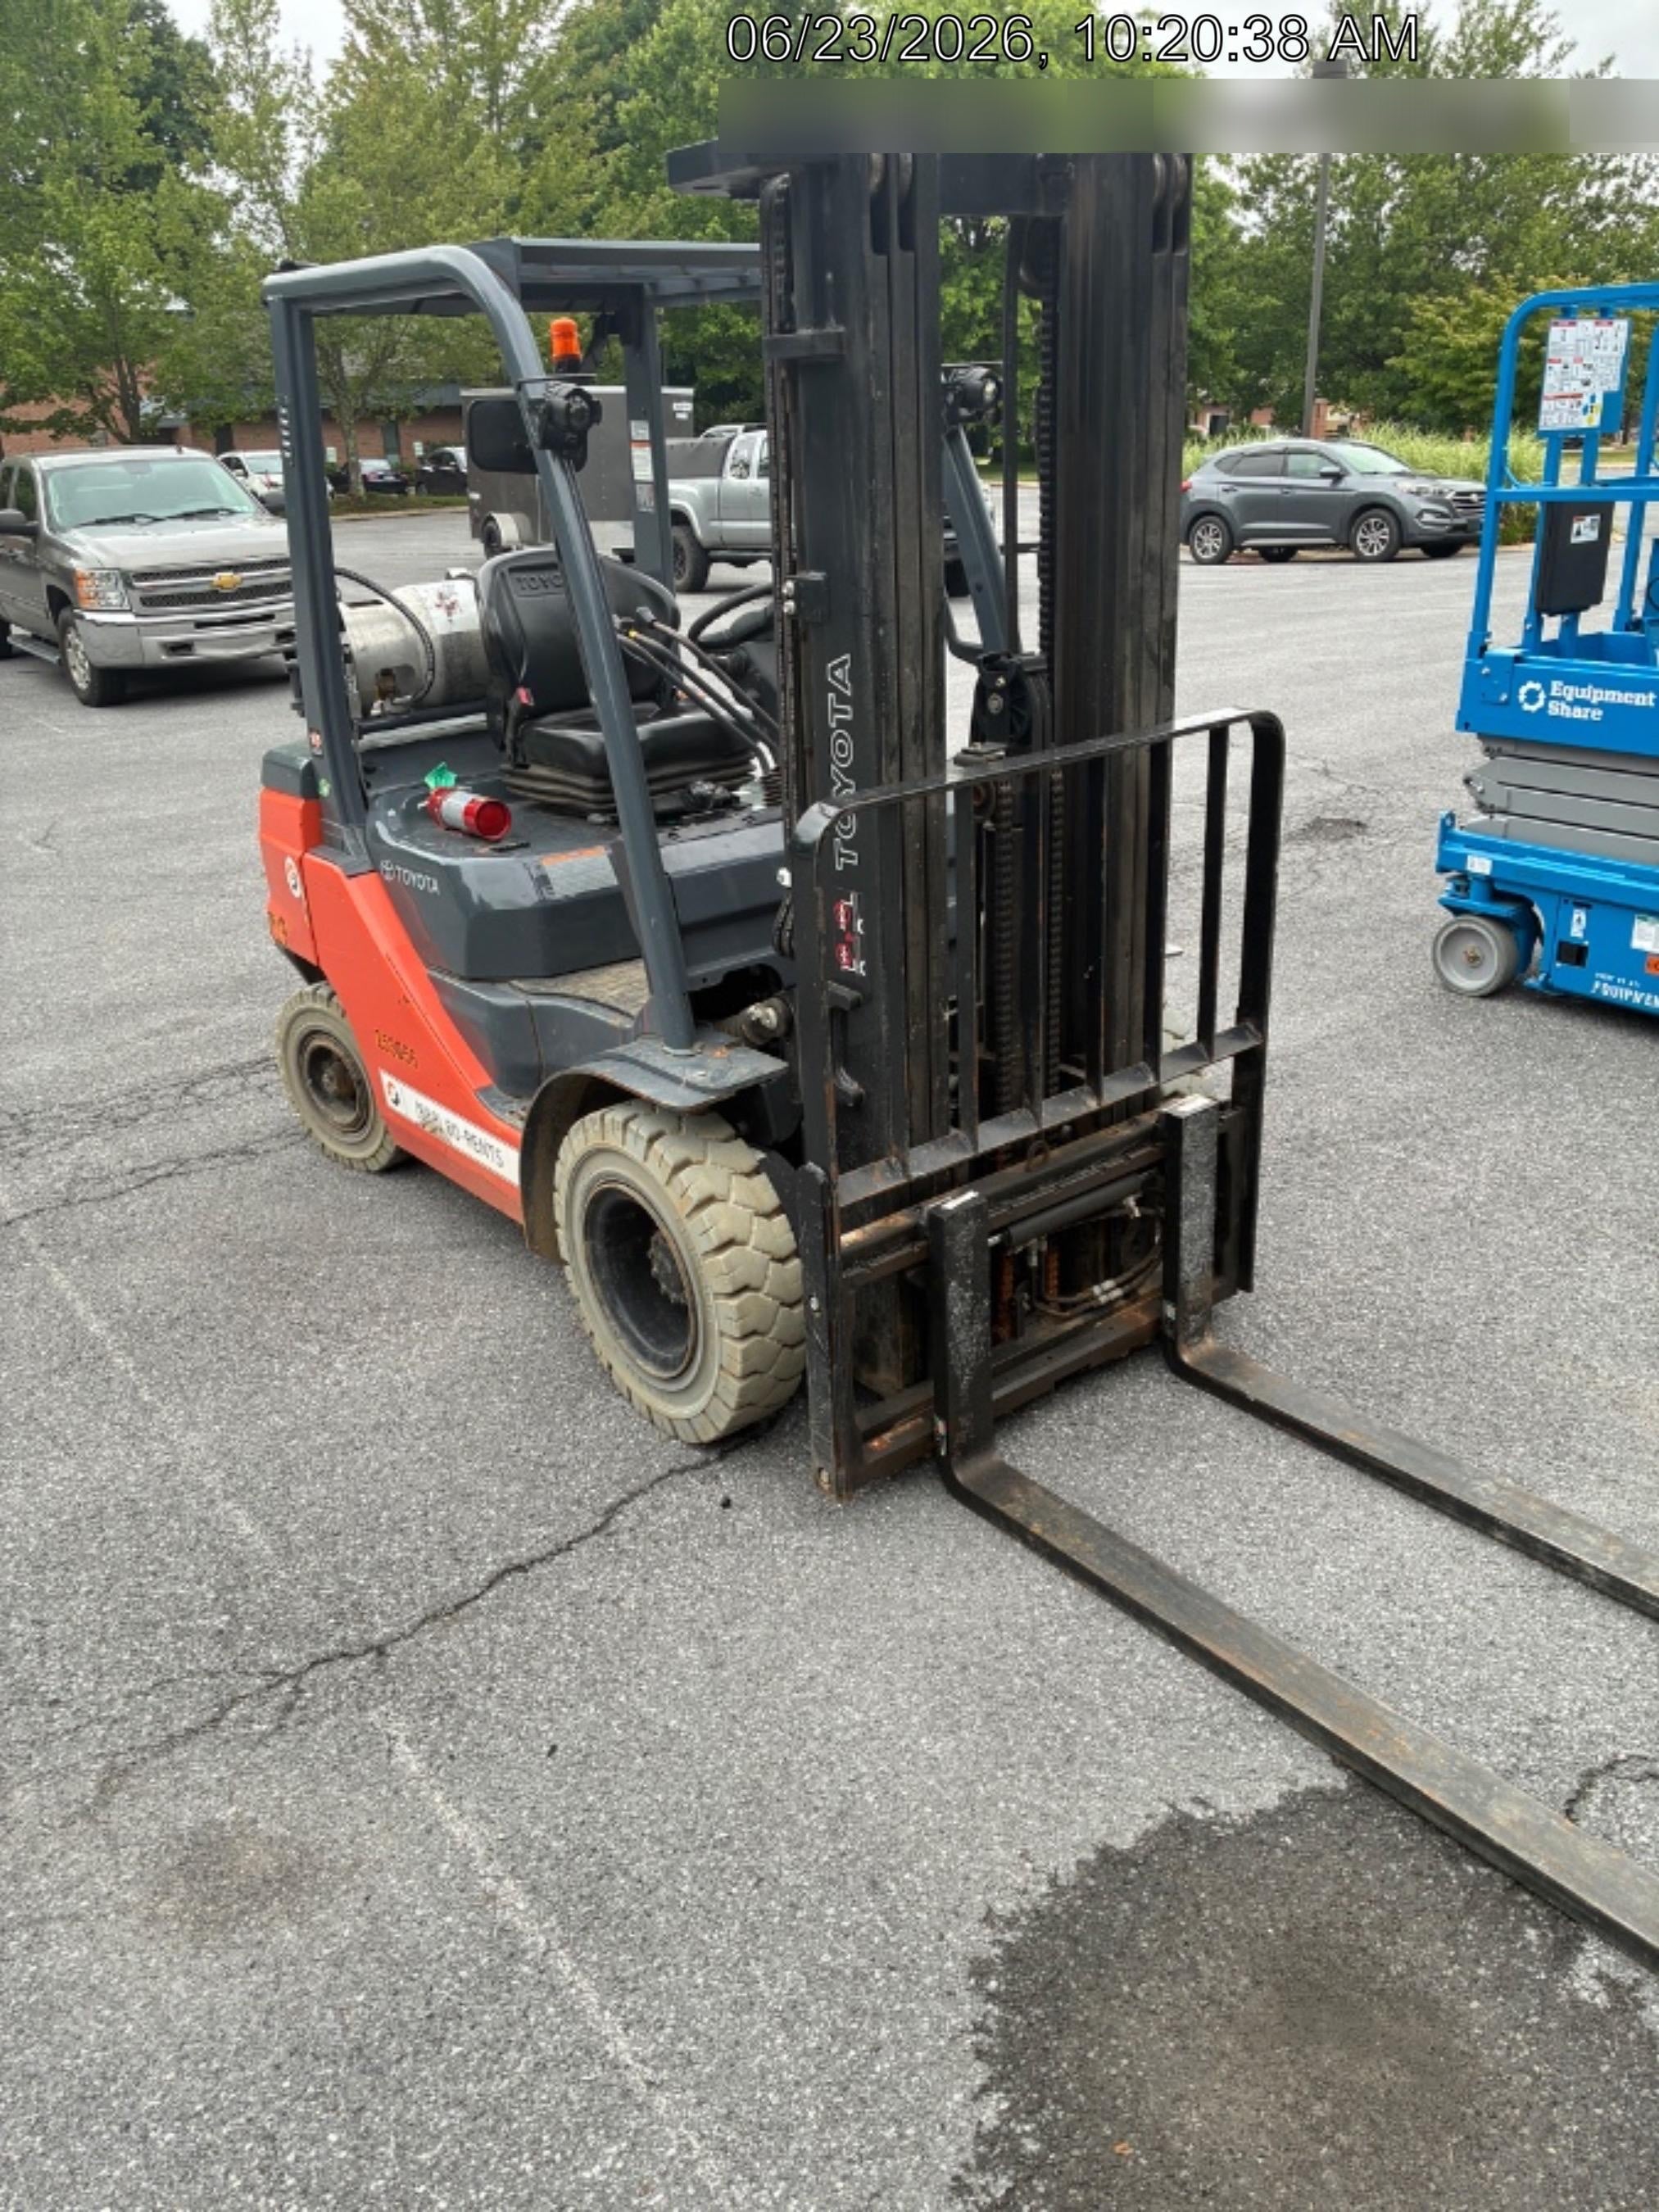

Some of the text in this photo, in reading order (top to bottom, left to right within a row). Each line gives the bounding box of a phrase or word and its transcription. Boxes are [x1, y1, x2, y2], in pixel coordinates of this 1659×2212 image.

[1549, 679, 1657, 707] Equipment
[1547, 700, 1603, 721] Share
[827, 653, 859, 871] TOYOTA
[395, 865, 441, 895] TOYOTA
